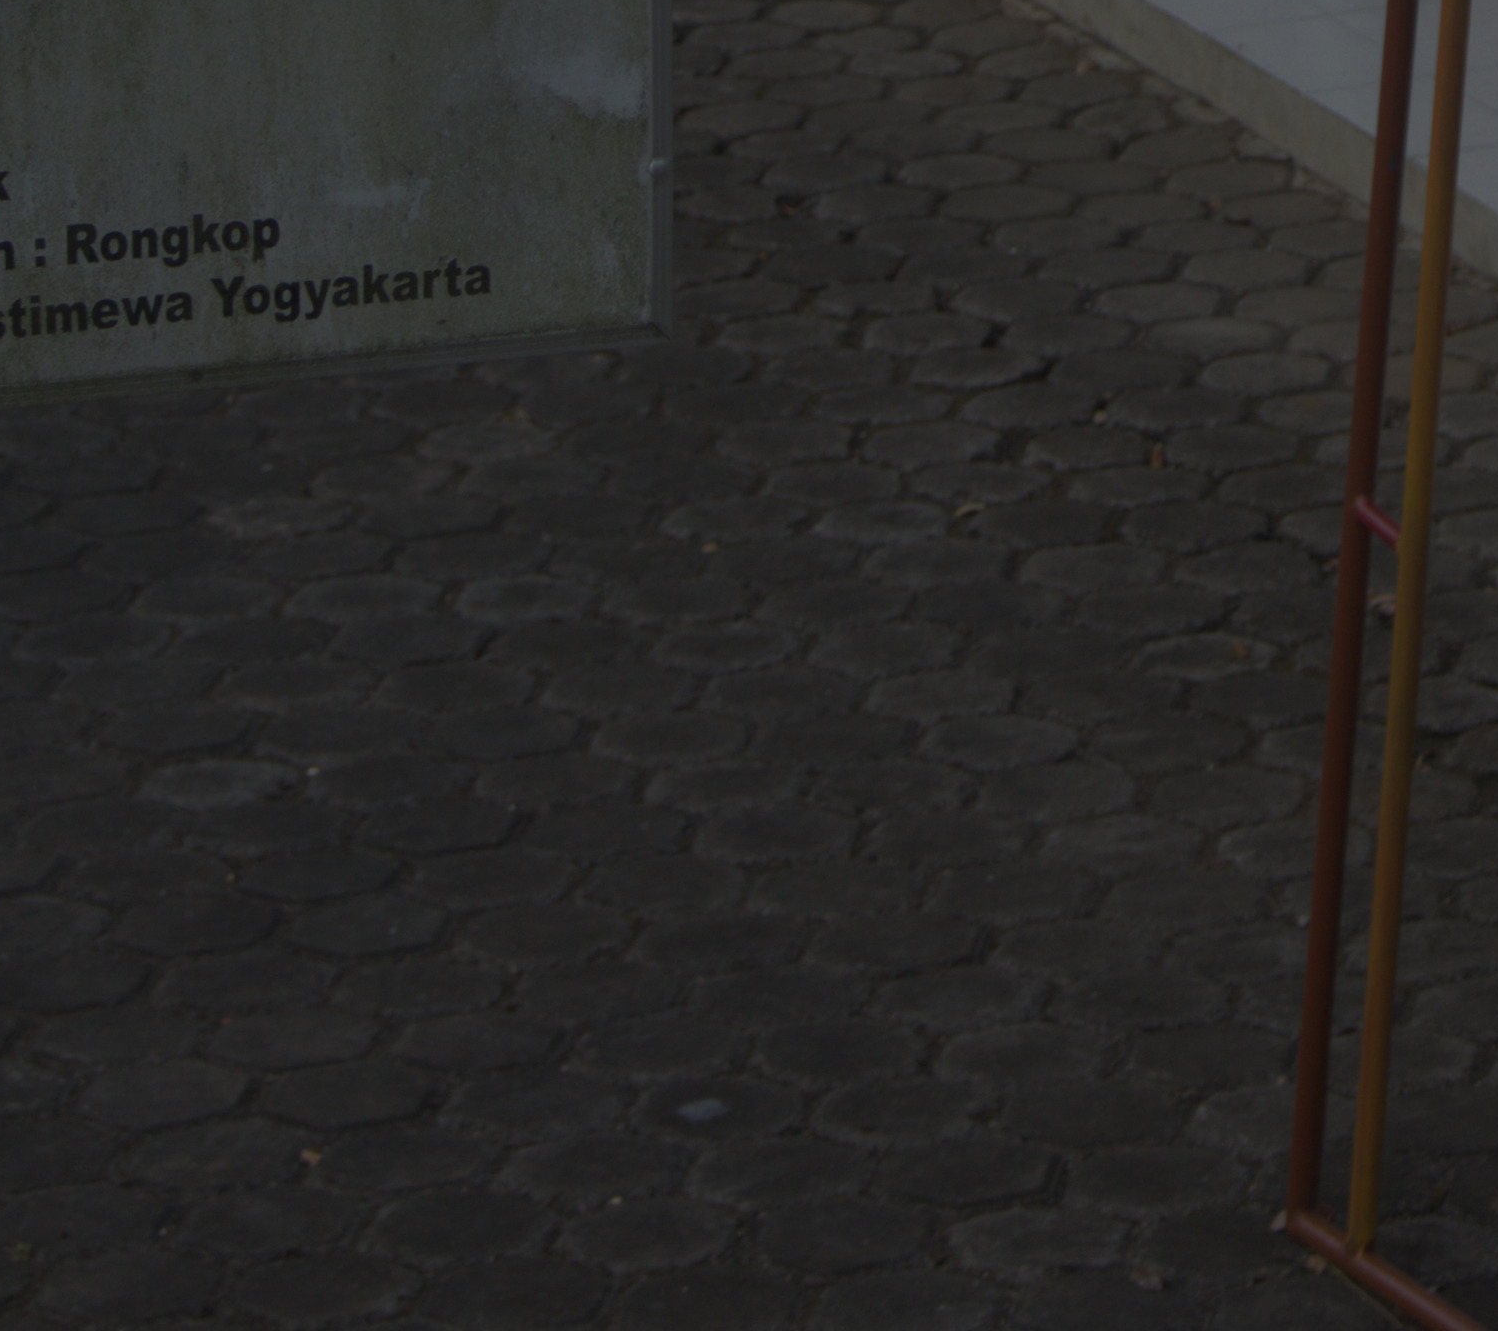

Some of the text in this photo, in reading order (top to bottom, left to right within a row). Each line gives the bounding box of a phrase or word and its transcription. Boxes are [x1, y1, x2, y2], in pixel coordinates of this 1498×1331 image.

[34, 237, 47, 269] :
[65, 213, 280, 269] Rongkop
[210, 258, 491, 325] Yogyakarta
